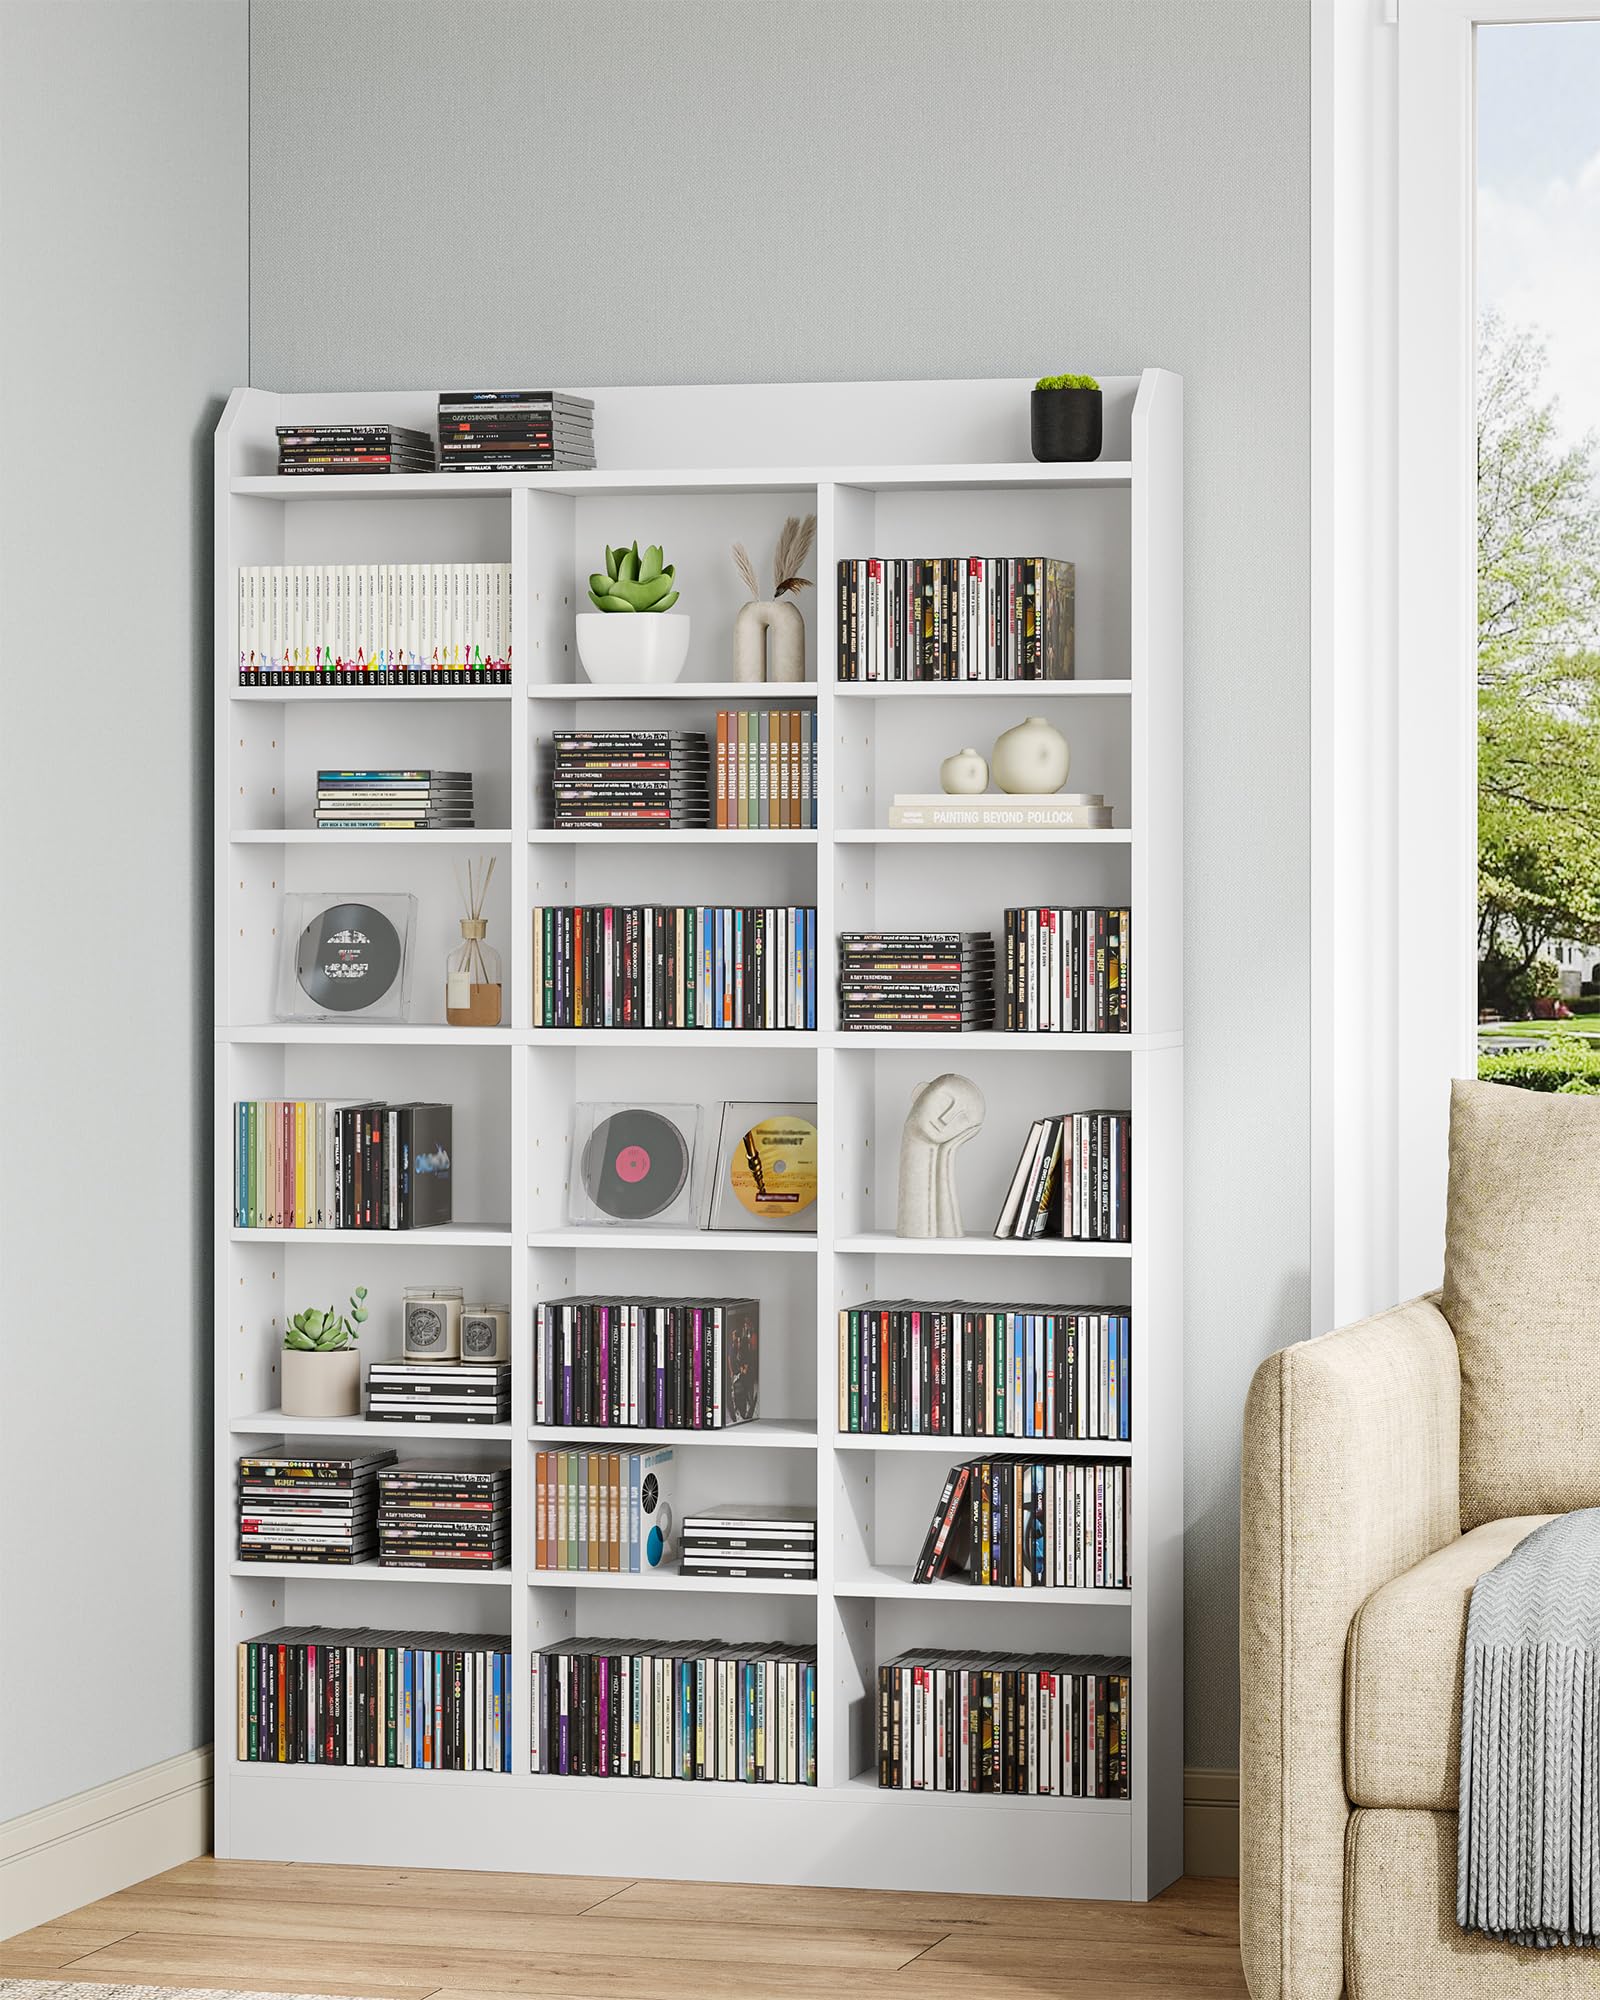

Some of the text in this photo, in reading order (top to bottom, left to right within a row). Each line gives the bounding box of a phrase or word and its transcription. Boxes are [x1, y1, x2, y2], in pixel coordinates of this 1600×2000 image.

[934, 811, 1073, 823] PAINTING BEYOND POLLOCK
